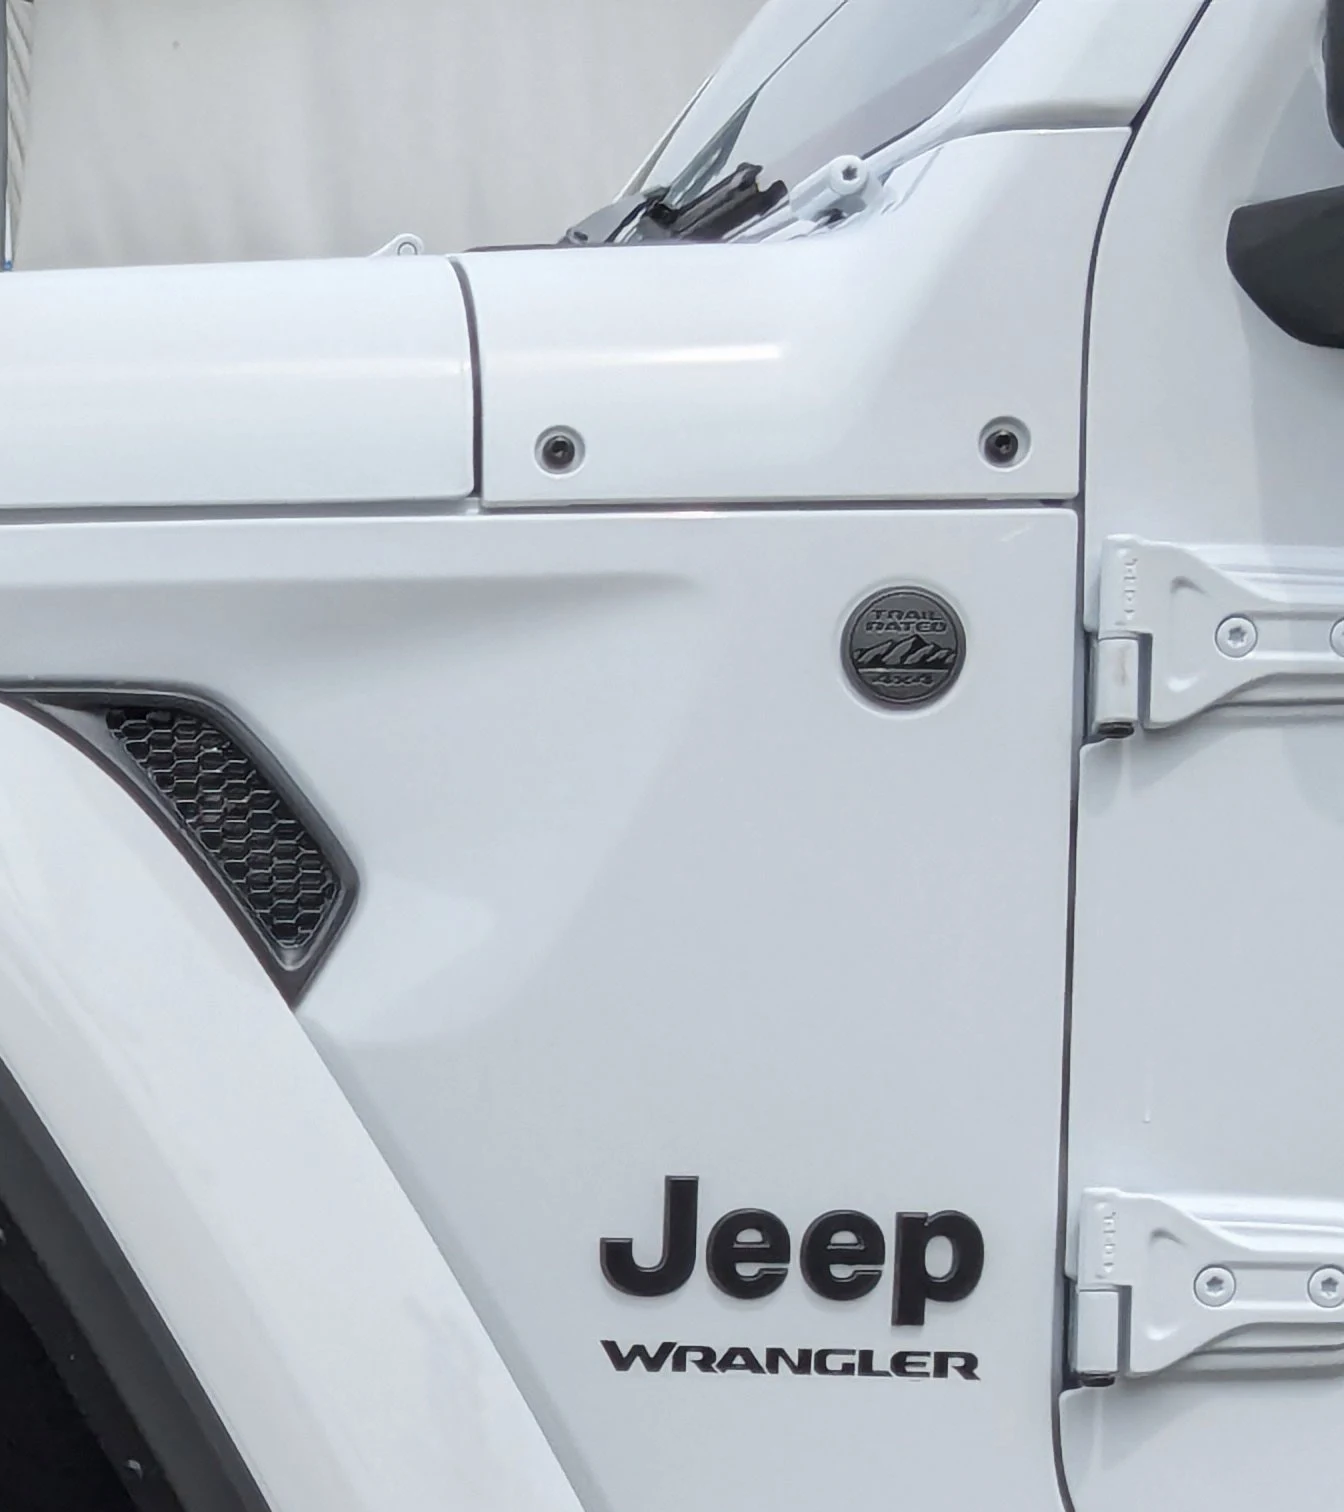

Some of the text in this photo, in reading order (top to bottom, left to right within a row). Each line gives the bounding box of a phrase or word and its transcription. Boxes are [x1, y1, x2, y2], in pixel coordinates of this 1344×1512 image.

[865, 622, 948, 634] RATED
[871, 609, 943, 621] TRAIL
[599, 1175, 985, 1326] Jeep
[600, 1339, 981, 1381] WRANGLER
